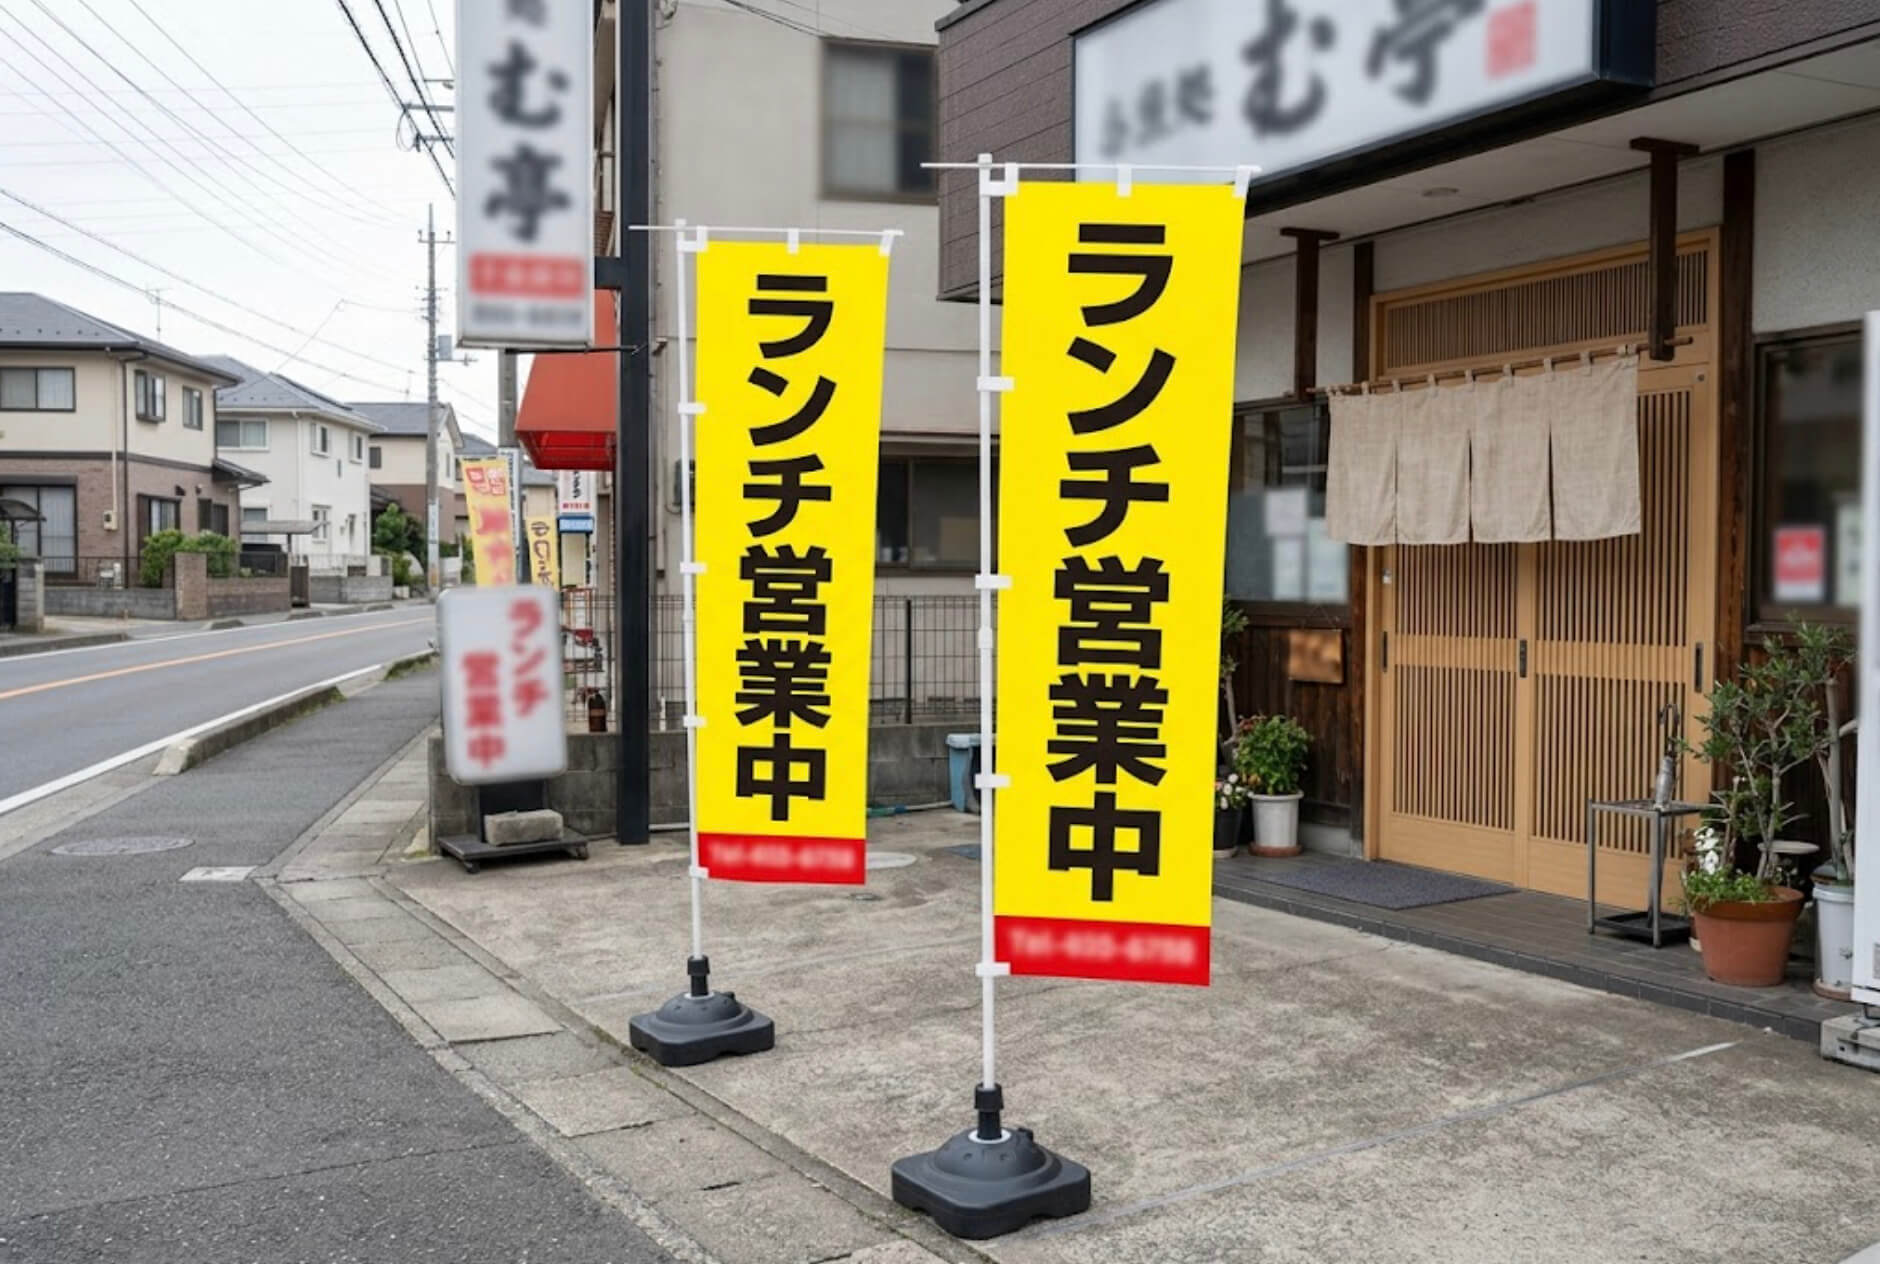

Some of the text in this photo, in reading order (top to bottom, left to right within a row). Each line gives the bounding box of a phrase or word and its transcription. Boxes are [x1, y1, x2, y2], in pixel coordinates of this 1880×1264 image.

[736, 275, 836, 821] ランチ営業中
[1046, 224, 1175, 901] ランチ営業中
